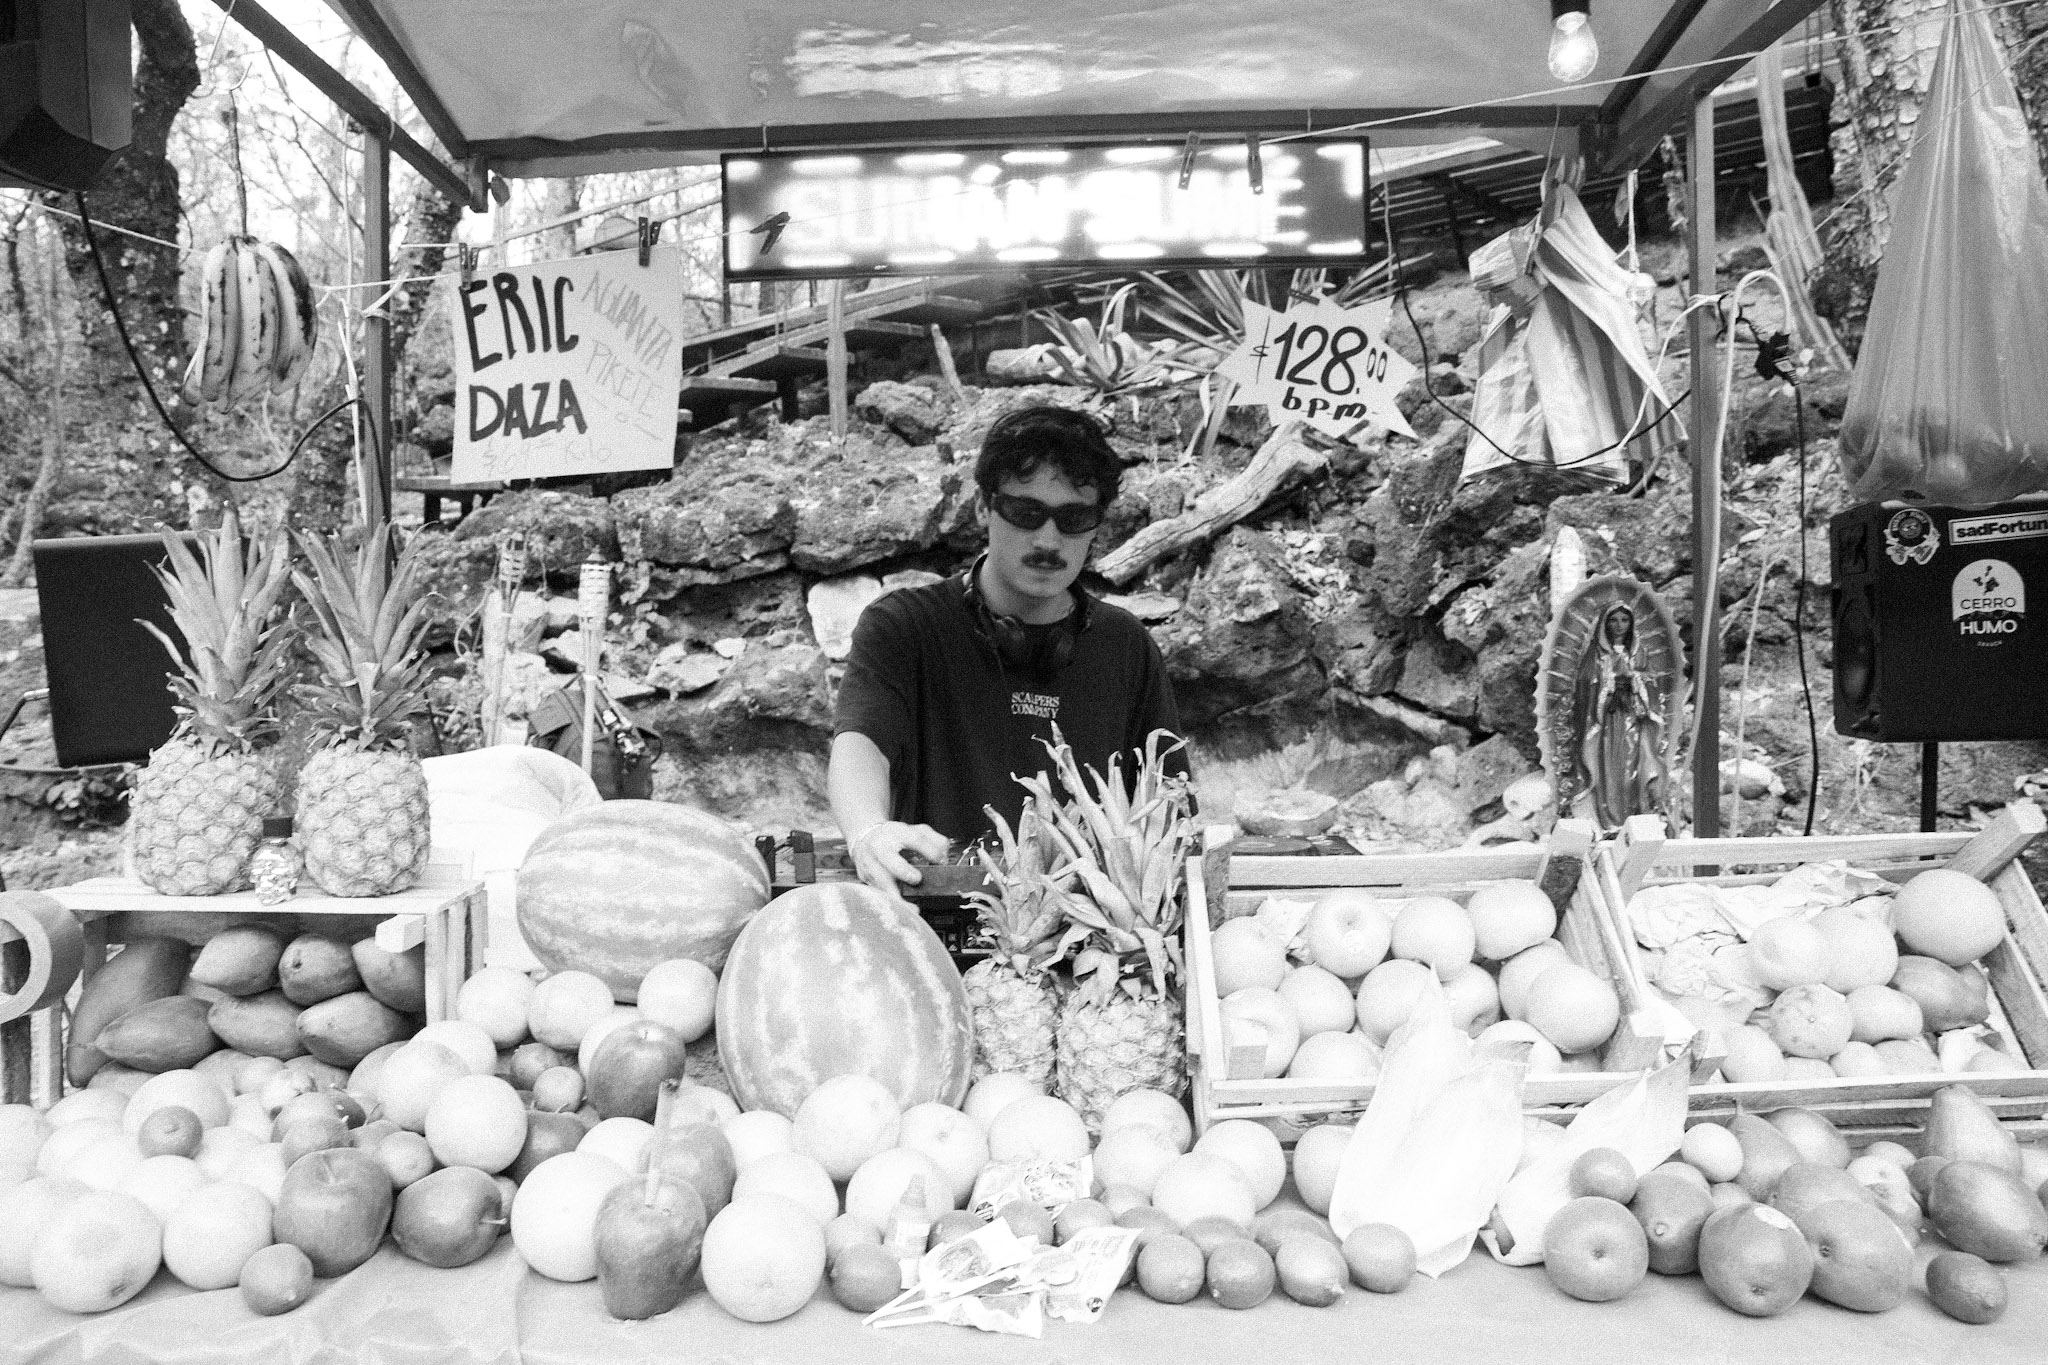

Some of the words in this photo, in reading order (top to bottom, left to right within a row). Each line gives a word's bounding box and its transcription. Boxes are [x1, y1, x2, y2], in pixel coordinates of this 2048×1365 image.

[458, 271, 580, 373] ERIC
[468, 378, 588, 443] DAZA
[1960, 596, 2017, 611] CERRO
[1959, 618, 2018, 635] HUMO
